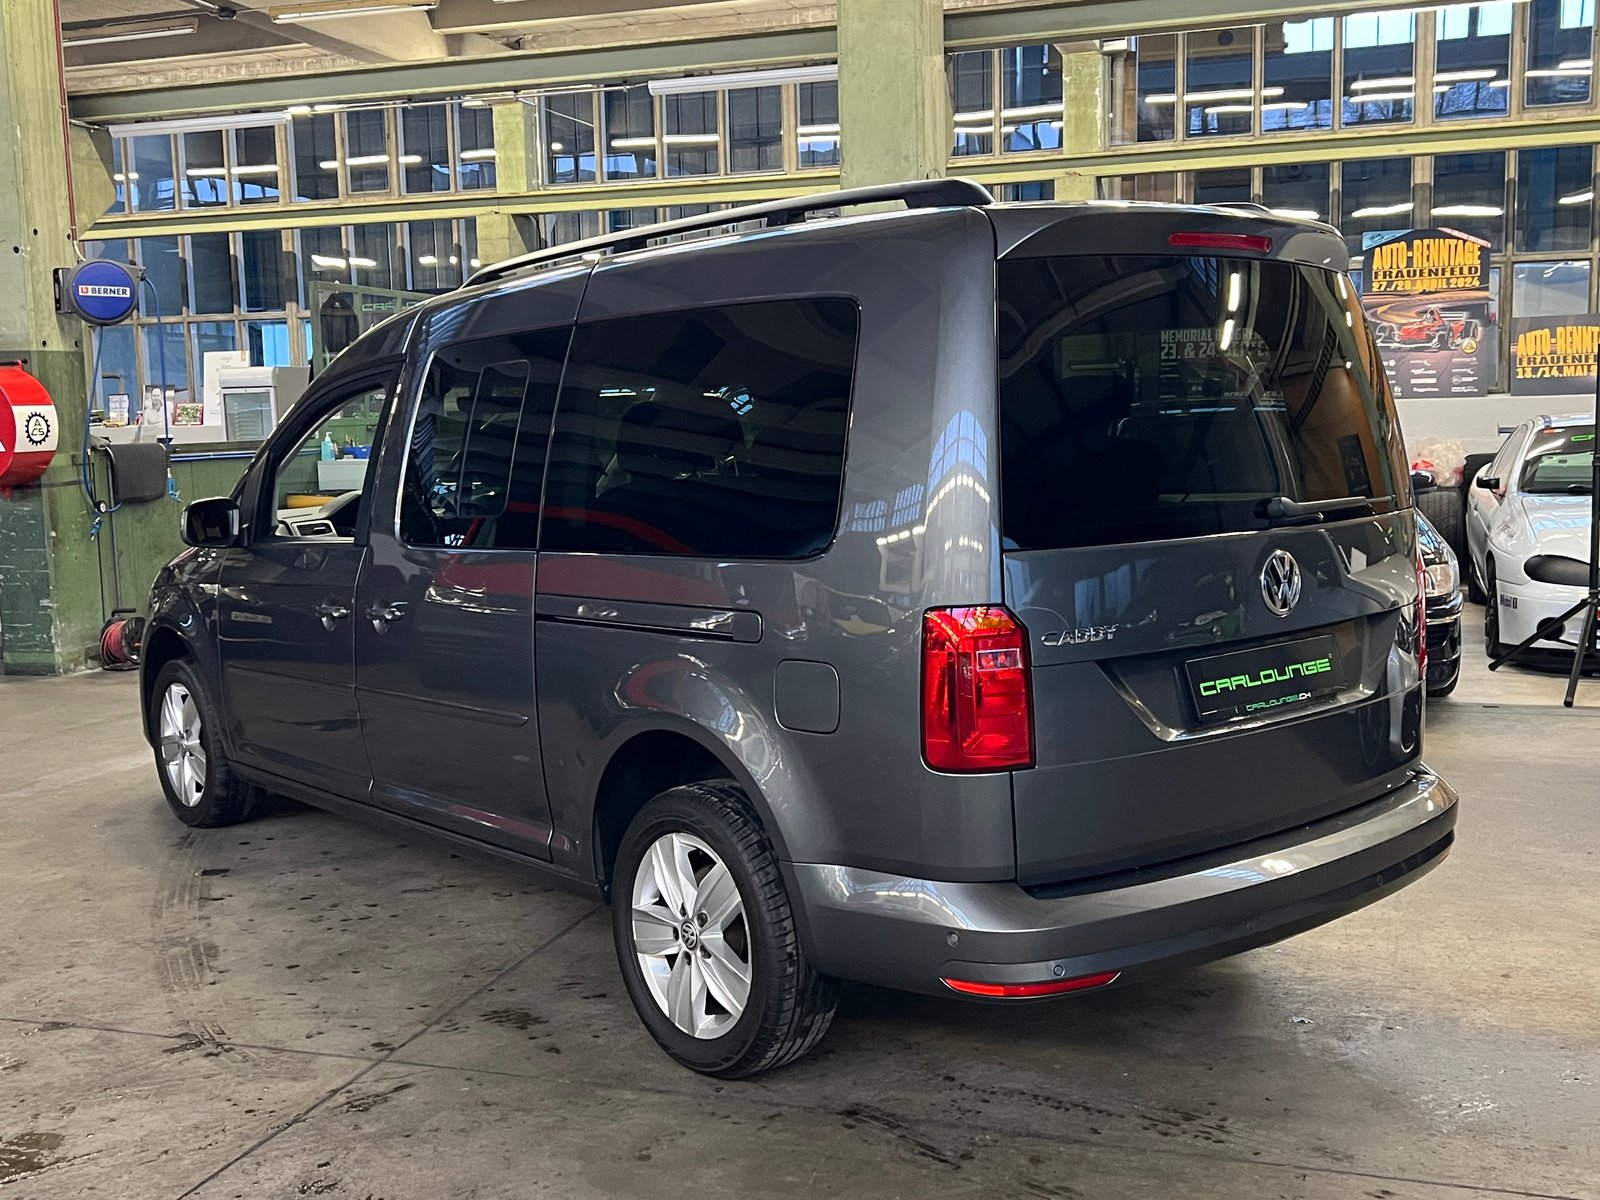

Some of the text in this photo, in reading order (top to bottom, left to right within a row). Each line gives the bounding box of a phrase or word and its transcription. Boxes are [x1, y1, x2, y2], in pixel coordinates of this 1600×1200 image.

[1372, 238, 1481, 270] AUTO-RENNTAGE
[1373, 265, 1480, 280] FRAUENFELD
[1449, 277, 1480, 289] 2024
[91, 287, 128, 296] BERNER
[1160, 328, 1213, 342] MEMORIAL
[1517, 326, 1600, 356] AUTO-RENNT
[1160, 343, 1181, 359] 23.
[1184, 343, 1196, 358] &
[1198, 342, 1219, 358] 24.
[34, 419, 41, 427] A
[1041, 623, 1119, 646] CADDY
[1199, 657, 1332, 696] CARLOUNGE
